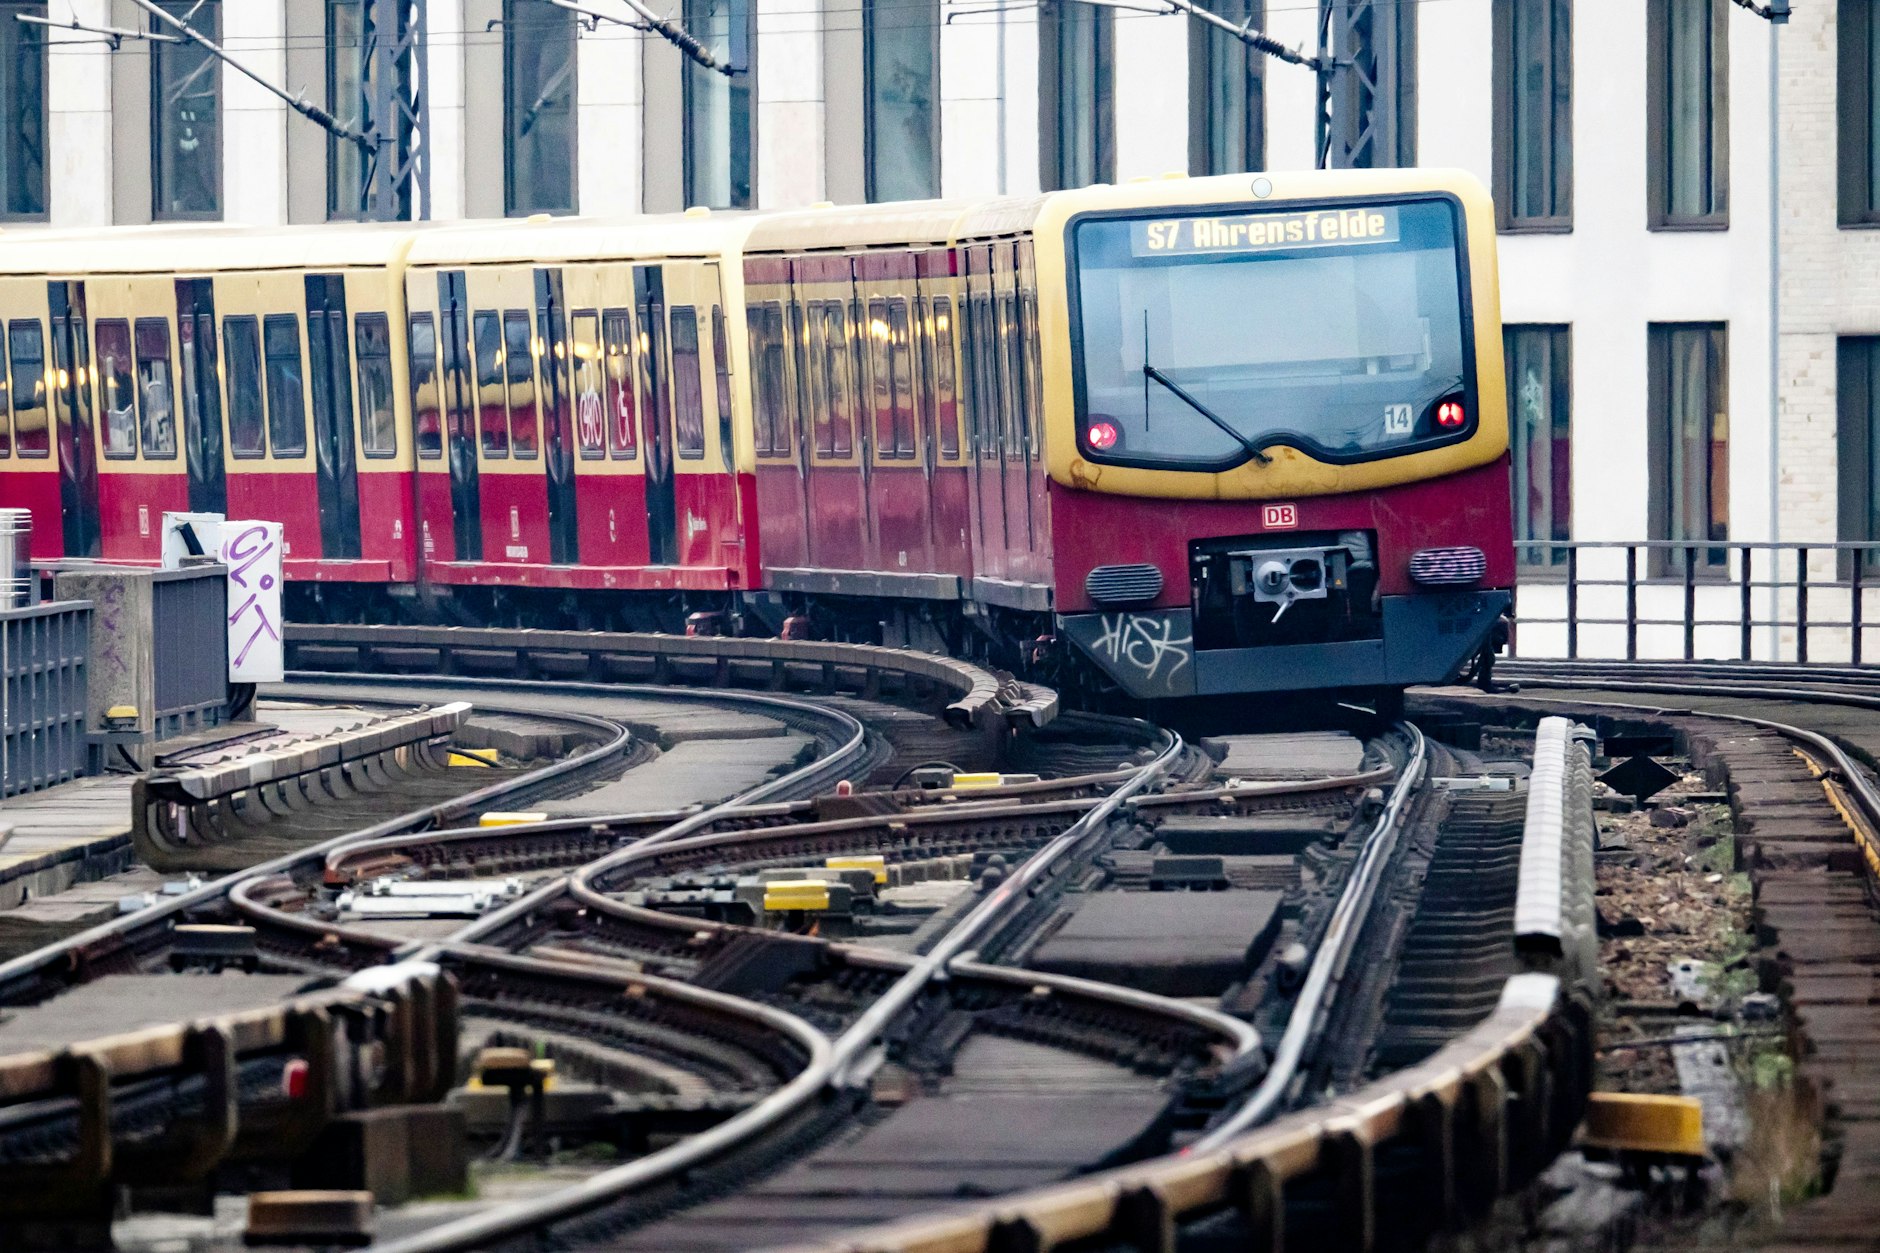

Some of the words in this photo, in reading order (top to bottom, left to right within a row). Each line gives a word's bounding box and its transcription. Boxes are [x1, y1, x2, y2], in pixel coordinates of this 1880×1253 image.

[1147, 220, 1180, 250] S7
[1193, 209, 1386, 248] Ahrensfelde
[1385, 406, 1410, 430] 14
[1266, 506, 1294, 524] DB
